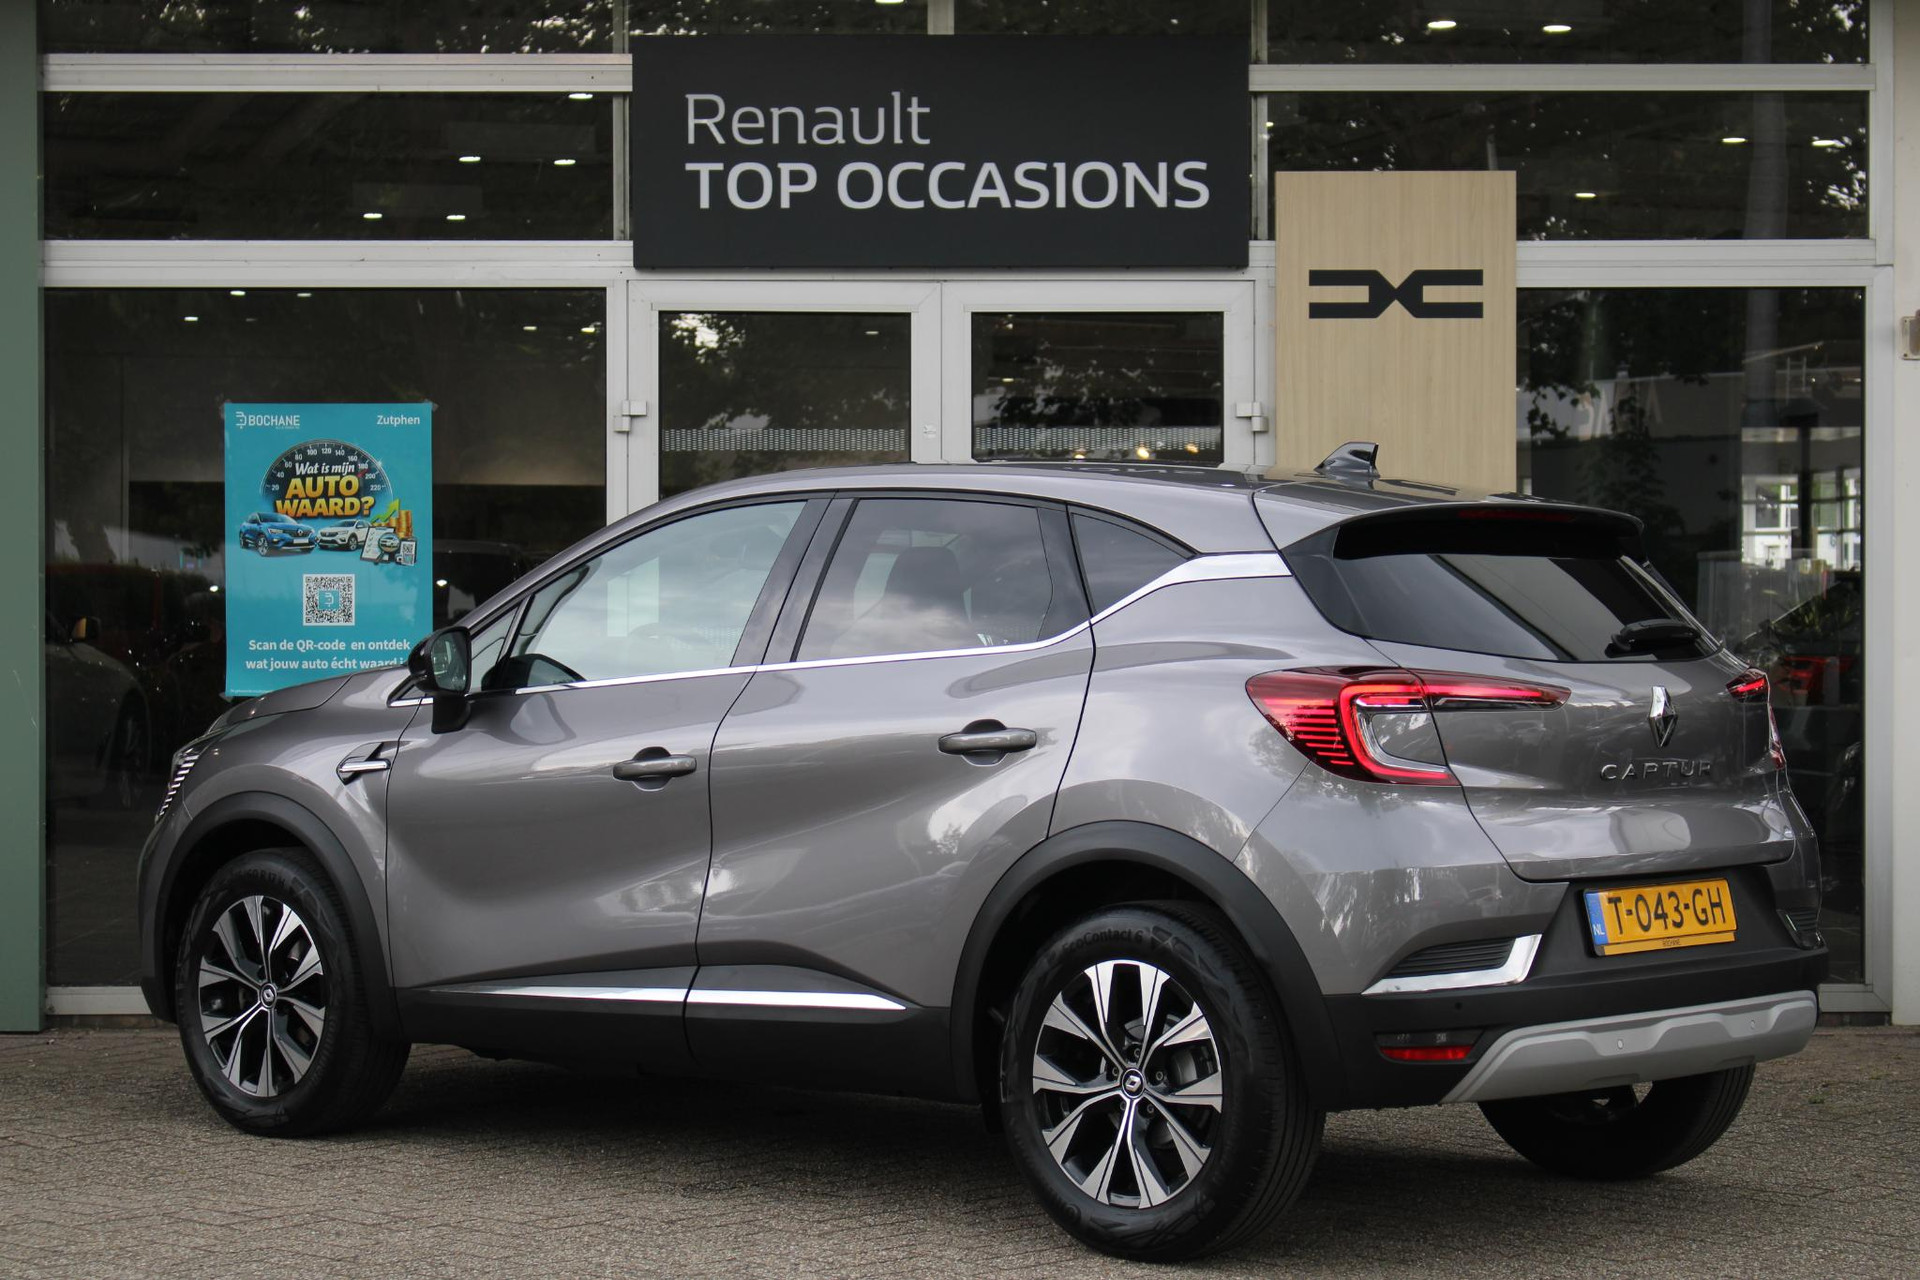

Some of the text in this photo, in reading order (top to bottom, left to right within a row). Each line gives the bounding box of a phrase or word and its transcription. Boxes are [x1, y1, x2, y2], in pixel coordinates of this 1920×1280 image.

[685, 91, 931, 145] Renault
[685, 161, 1211, 209] TOP OCCASIONS
[248, 415, 300, 427] BOCHANE
[377, 415, 420, 429] Zutphen
[307, 448, 318, 456] 100
[276, 471, 284, 479] 40
[295, 462, 355, 476] Wat is mijn
[365, 472, 376, 480] 200
[285, 475, 359, 499] AUTO
[275, 496, 376, 518] WAARD?
[248, 638, 410, 653] Scan de QR-code en ontdek
[246, 658, 268, 669] wat
[270, 657, 299, 672] jouw
[302, 658, 328, 669] auto
[331, 657, 357, 669] écht
[360, 658, 397, 669] waard
[1600, 760, 1711, 780] CAPTUR
[1607, 887, 1727, 936] T-043-GH
[1592, 924, 1606, 935] NL
